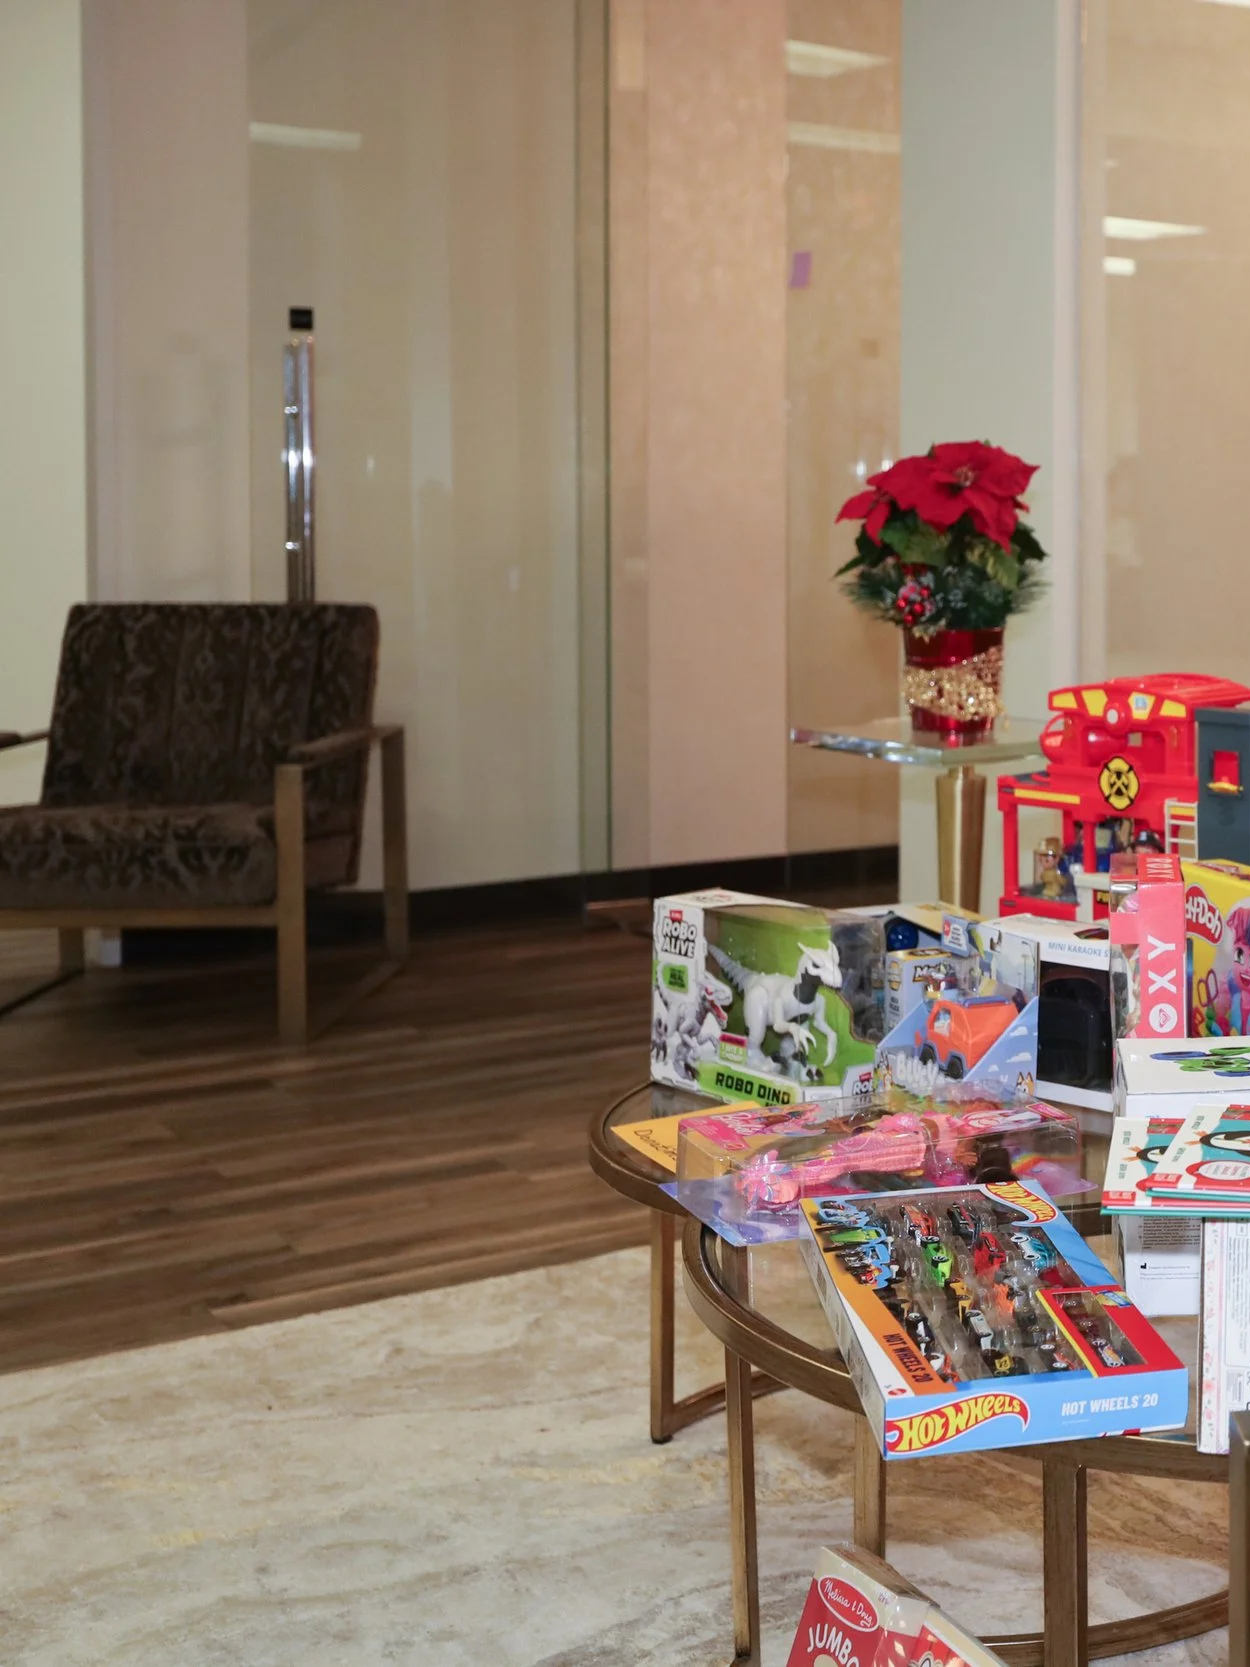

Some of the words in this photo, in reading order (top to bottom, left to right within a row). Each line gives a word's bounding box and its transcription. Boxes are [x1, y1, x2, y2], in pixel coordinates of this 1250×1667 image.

[663, 916, 697, 941] ROBO
[1186, 896, 1222, 940] ay-Doh
[662, 936, 695, 959] ALIVE
[1048, 942, 1066, 951] MINI
[1067, 945, 1102, 957] KARAOKE
[715, 1072, 754, 1095] ROBO
[757, 1084, 791, 1105] DINO
[884, 1333, 906, 1346] HOT
[893, 1347, 925, 1372] WHEELS
[912, 1373, 933, 1382] 20
[1062, 1400, 1086, 1416] HOT
[1090, 1395, 1140, 1414] WHEELS
[1143, 1393, 1159, 1408] 20
[824, 1579, 851, 1608] Melissa
